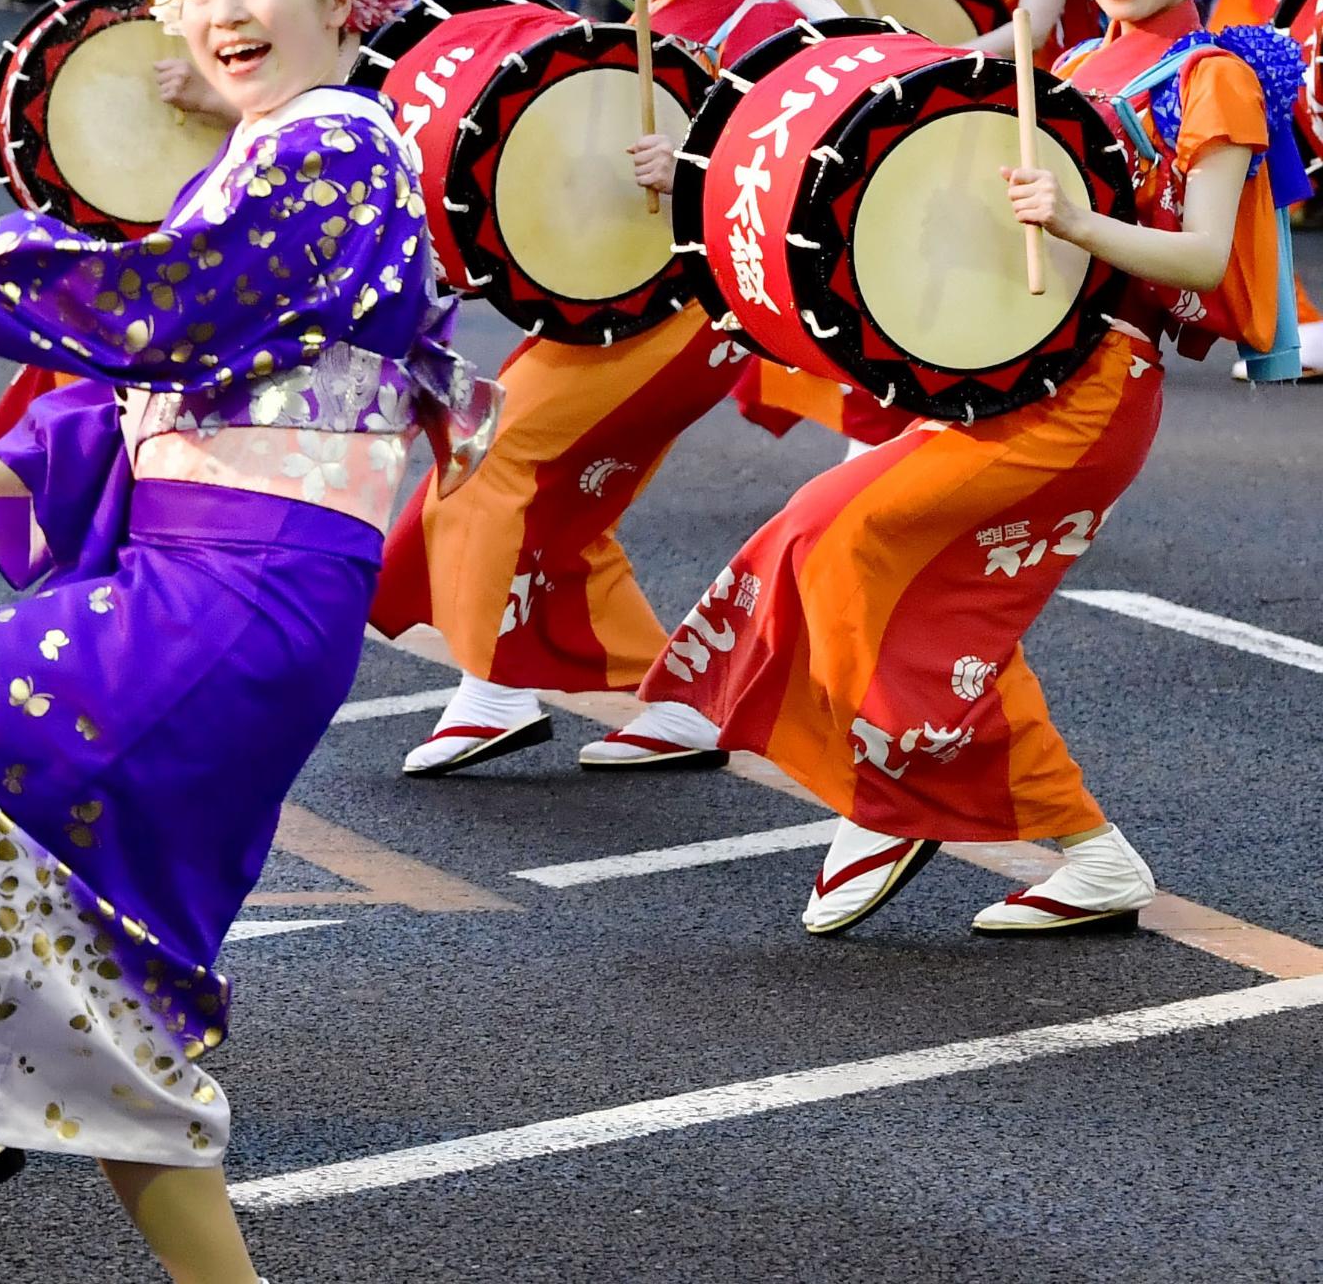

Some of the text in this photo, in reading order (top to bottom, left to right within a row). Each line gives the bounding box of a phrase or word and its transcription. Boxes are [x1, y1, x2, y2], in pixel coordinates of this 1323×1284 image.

[725, 45, 886, 316] ミス太鼓
[975, 520, 1032, 547] 盛岡
[734, 572, 762, 617] 盛岡
